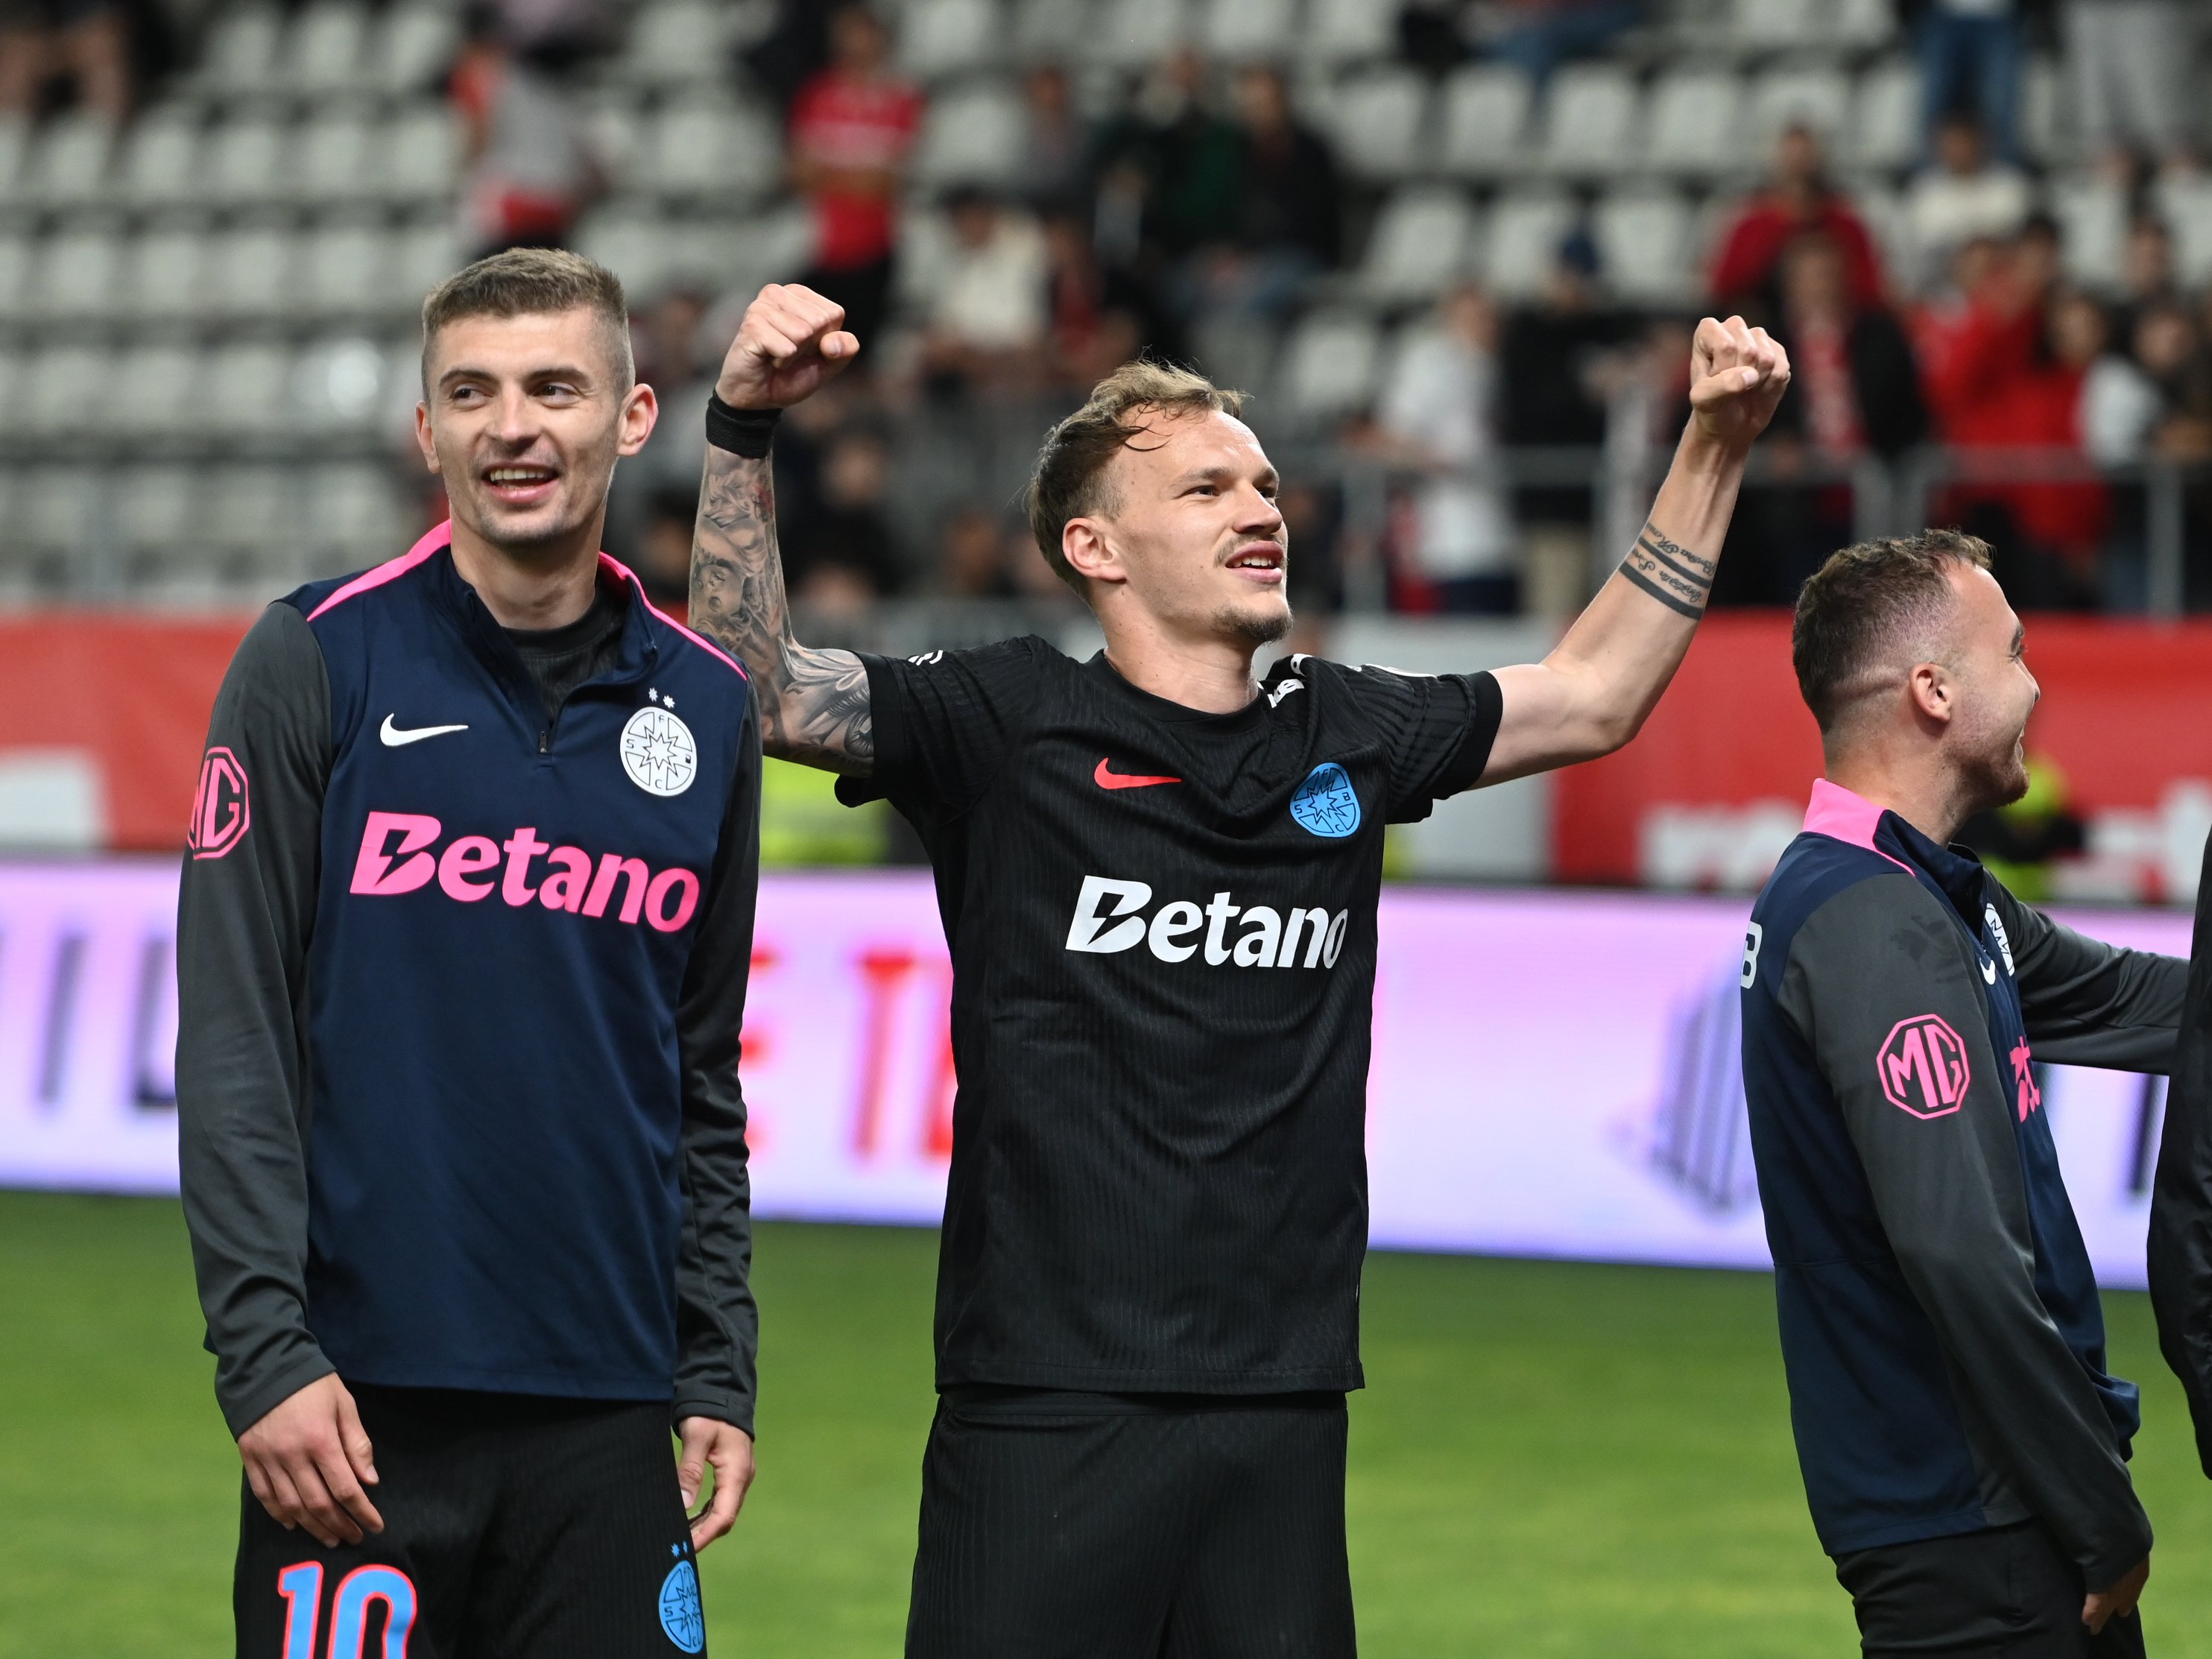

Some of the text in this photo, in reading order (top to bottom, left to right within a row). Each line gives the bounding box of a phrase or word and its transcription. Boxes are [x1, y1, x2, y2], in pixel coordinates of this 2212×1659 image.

[350, 811, 701, 933] Betano
[1065, 874, 1349, 970] Betano
[1884, 1020, 1965, 1110] MG
[277, 1560, 418, 1659] 10
